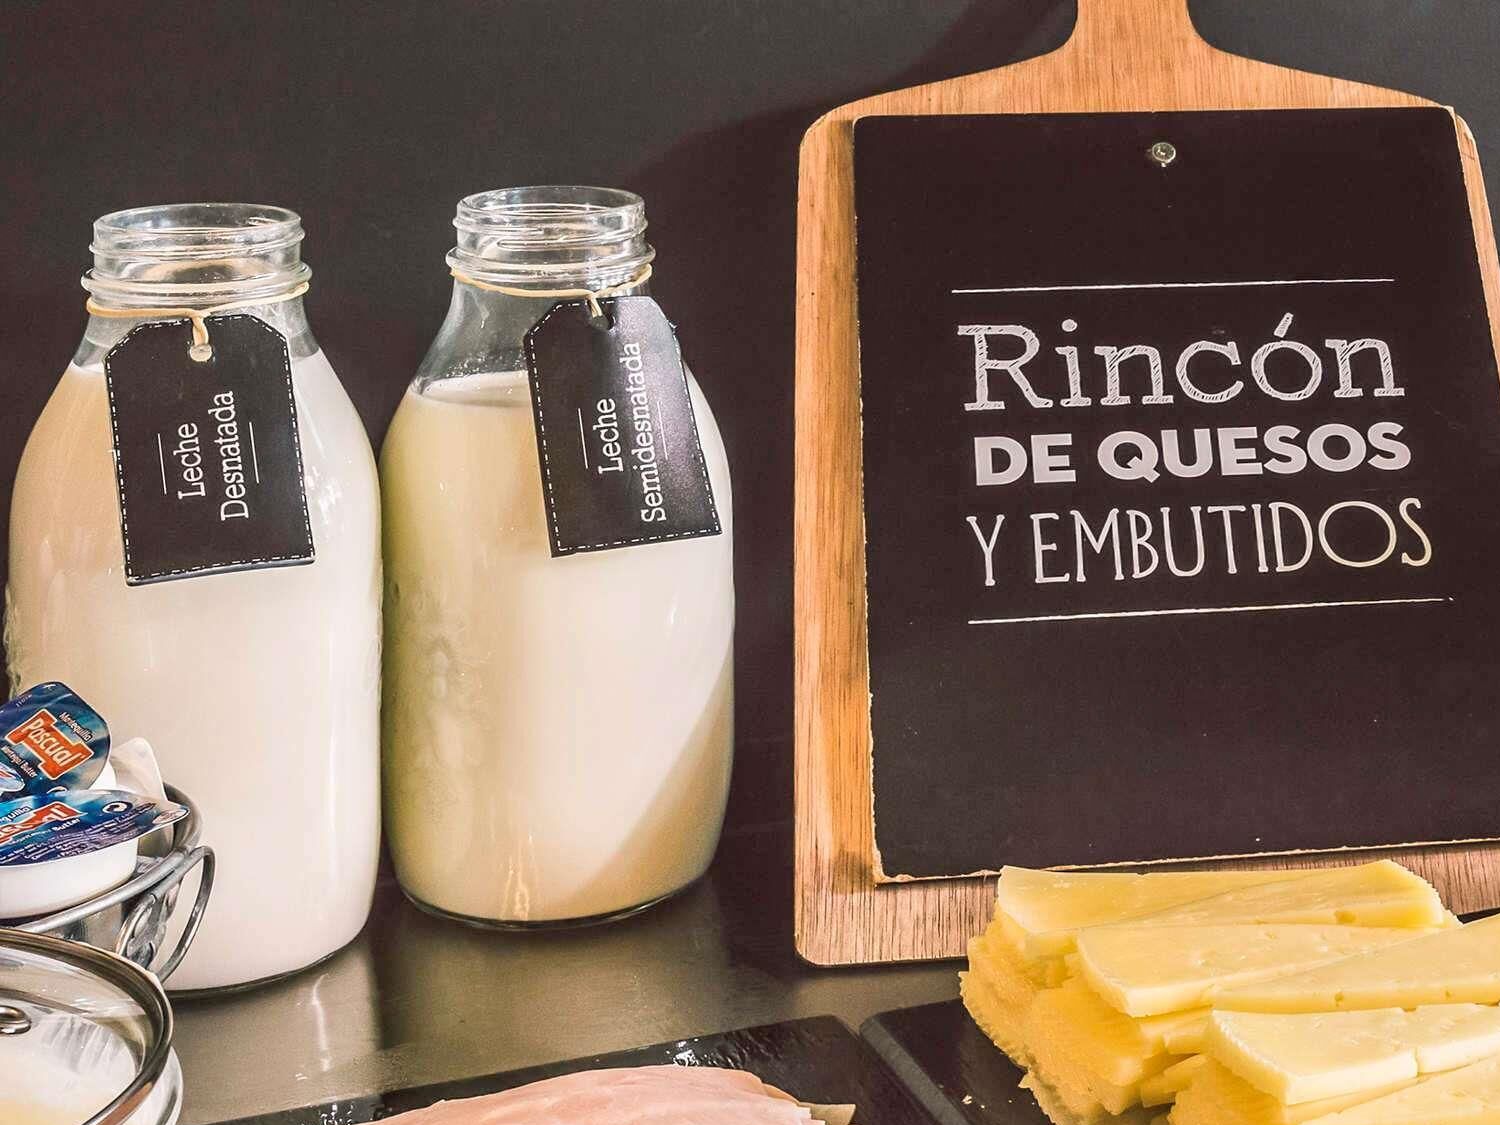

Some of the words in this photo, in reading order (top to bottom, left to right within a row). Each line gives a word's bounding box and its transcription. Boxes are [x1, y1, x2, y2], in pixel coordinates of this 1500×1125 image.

[957, 312, 1405, 411] Rincón
[173, 422, 207, 500] Leche
[208, 391, 249, 521] Desnatada
[592, 398, 625, 475] Leche
[624, 342, 667, 524] Semidesnatada
[974, 433, 1077, 486] DE
[1097, 421, 1411, 483] QUESOS
[966, 514, 1004, 586] Y
[1030, 497, 1432, 584] EMBUTIDOS
[21, 717, 82, 766] Pascual
[52, 817, 81, 832] Butter
